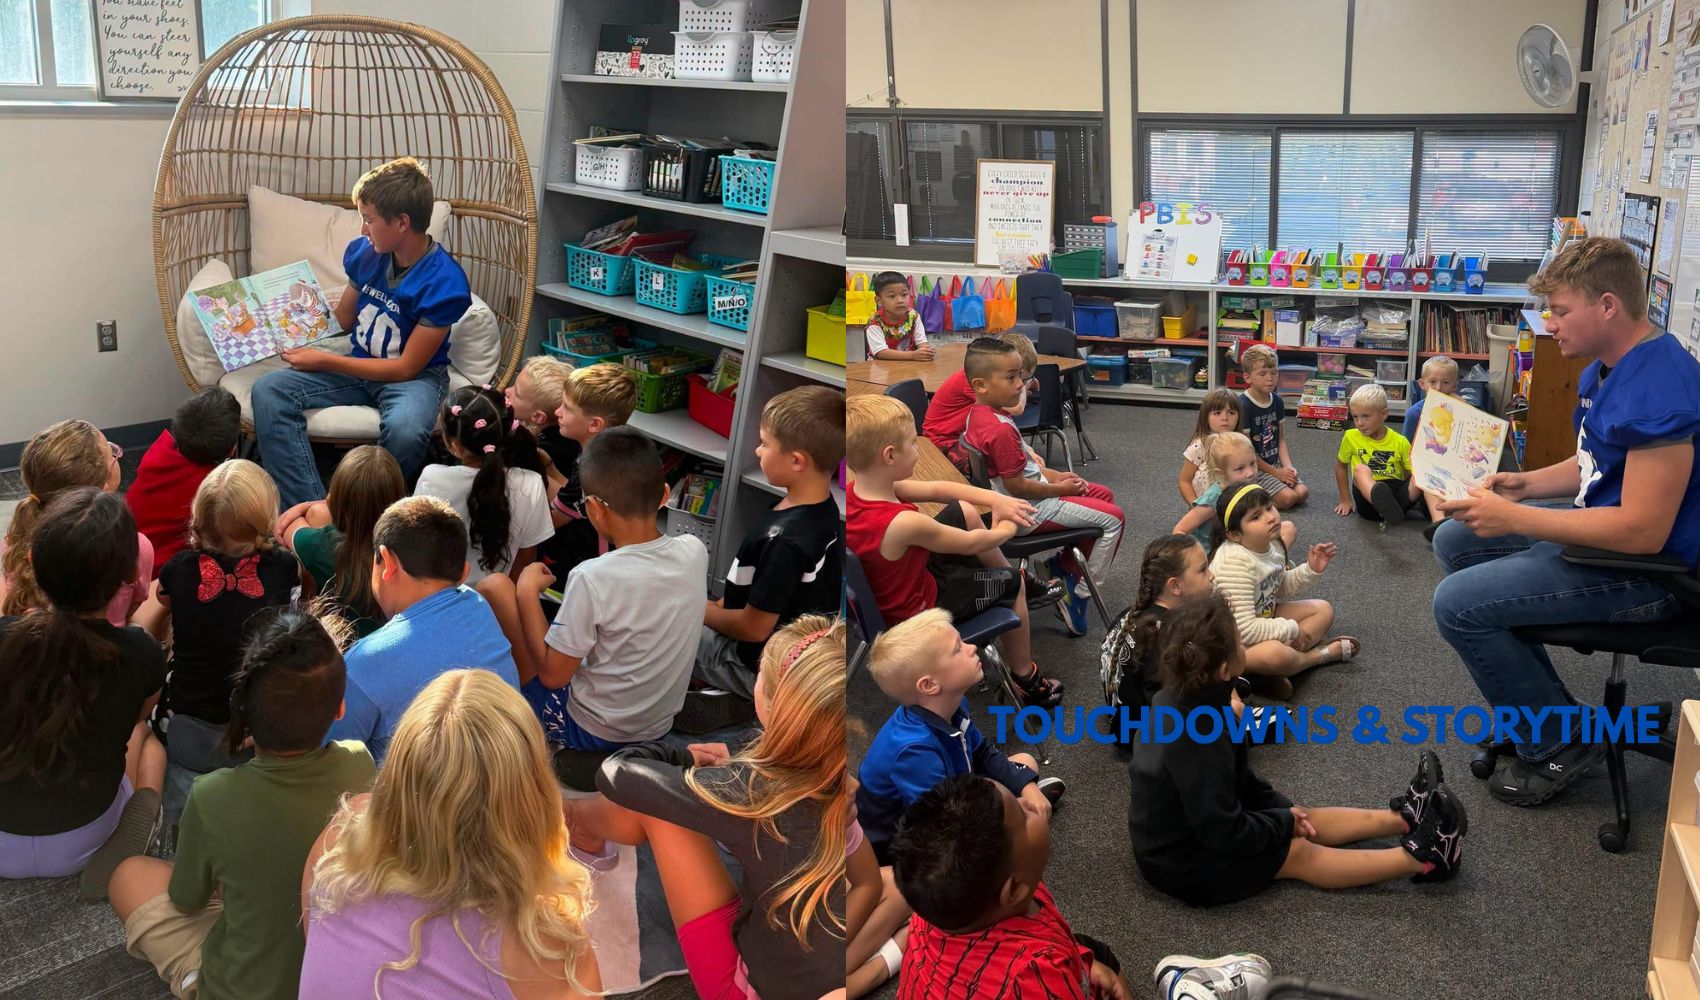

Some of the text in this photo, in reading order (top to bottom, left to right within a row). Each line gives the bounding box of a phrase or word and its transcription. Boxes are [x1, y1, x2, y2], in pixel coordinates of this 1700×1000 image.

[103, 10, 117, 20] in
[120, 15, 152, 29] your
[104, 25, 190, 44] You can steer
[107, 43, 192, 66] yourself any
[108, 60, 193, 83] direction you
[991, 177, 1043, 185] champion
[1139, 201, 1212, 225] PBIS
[717, 298, 746, 308] M/N/O
